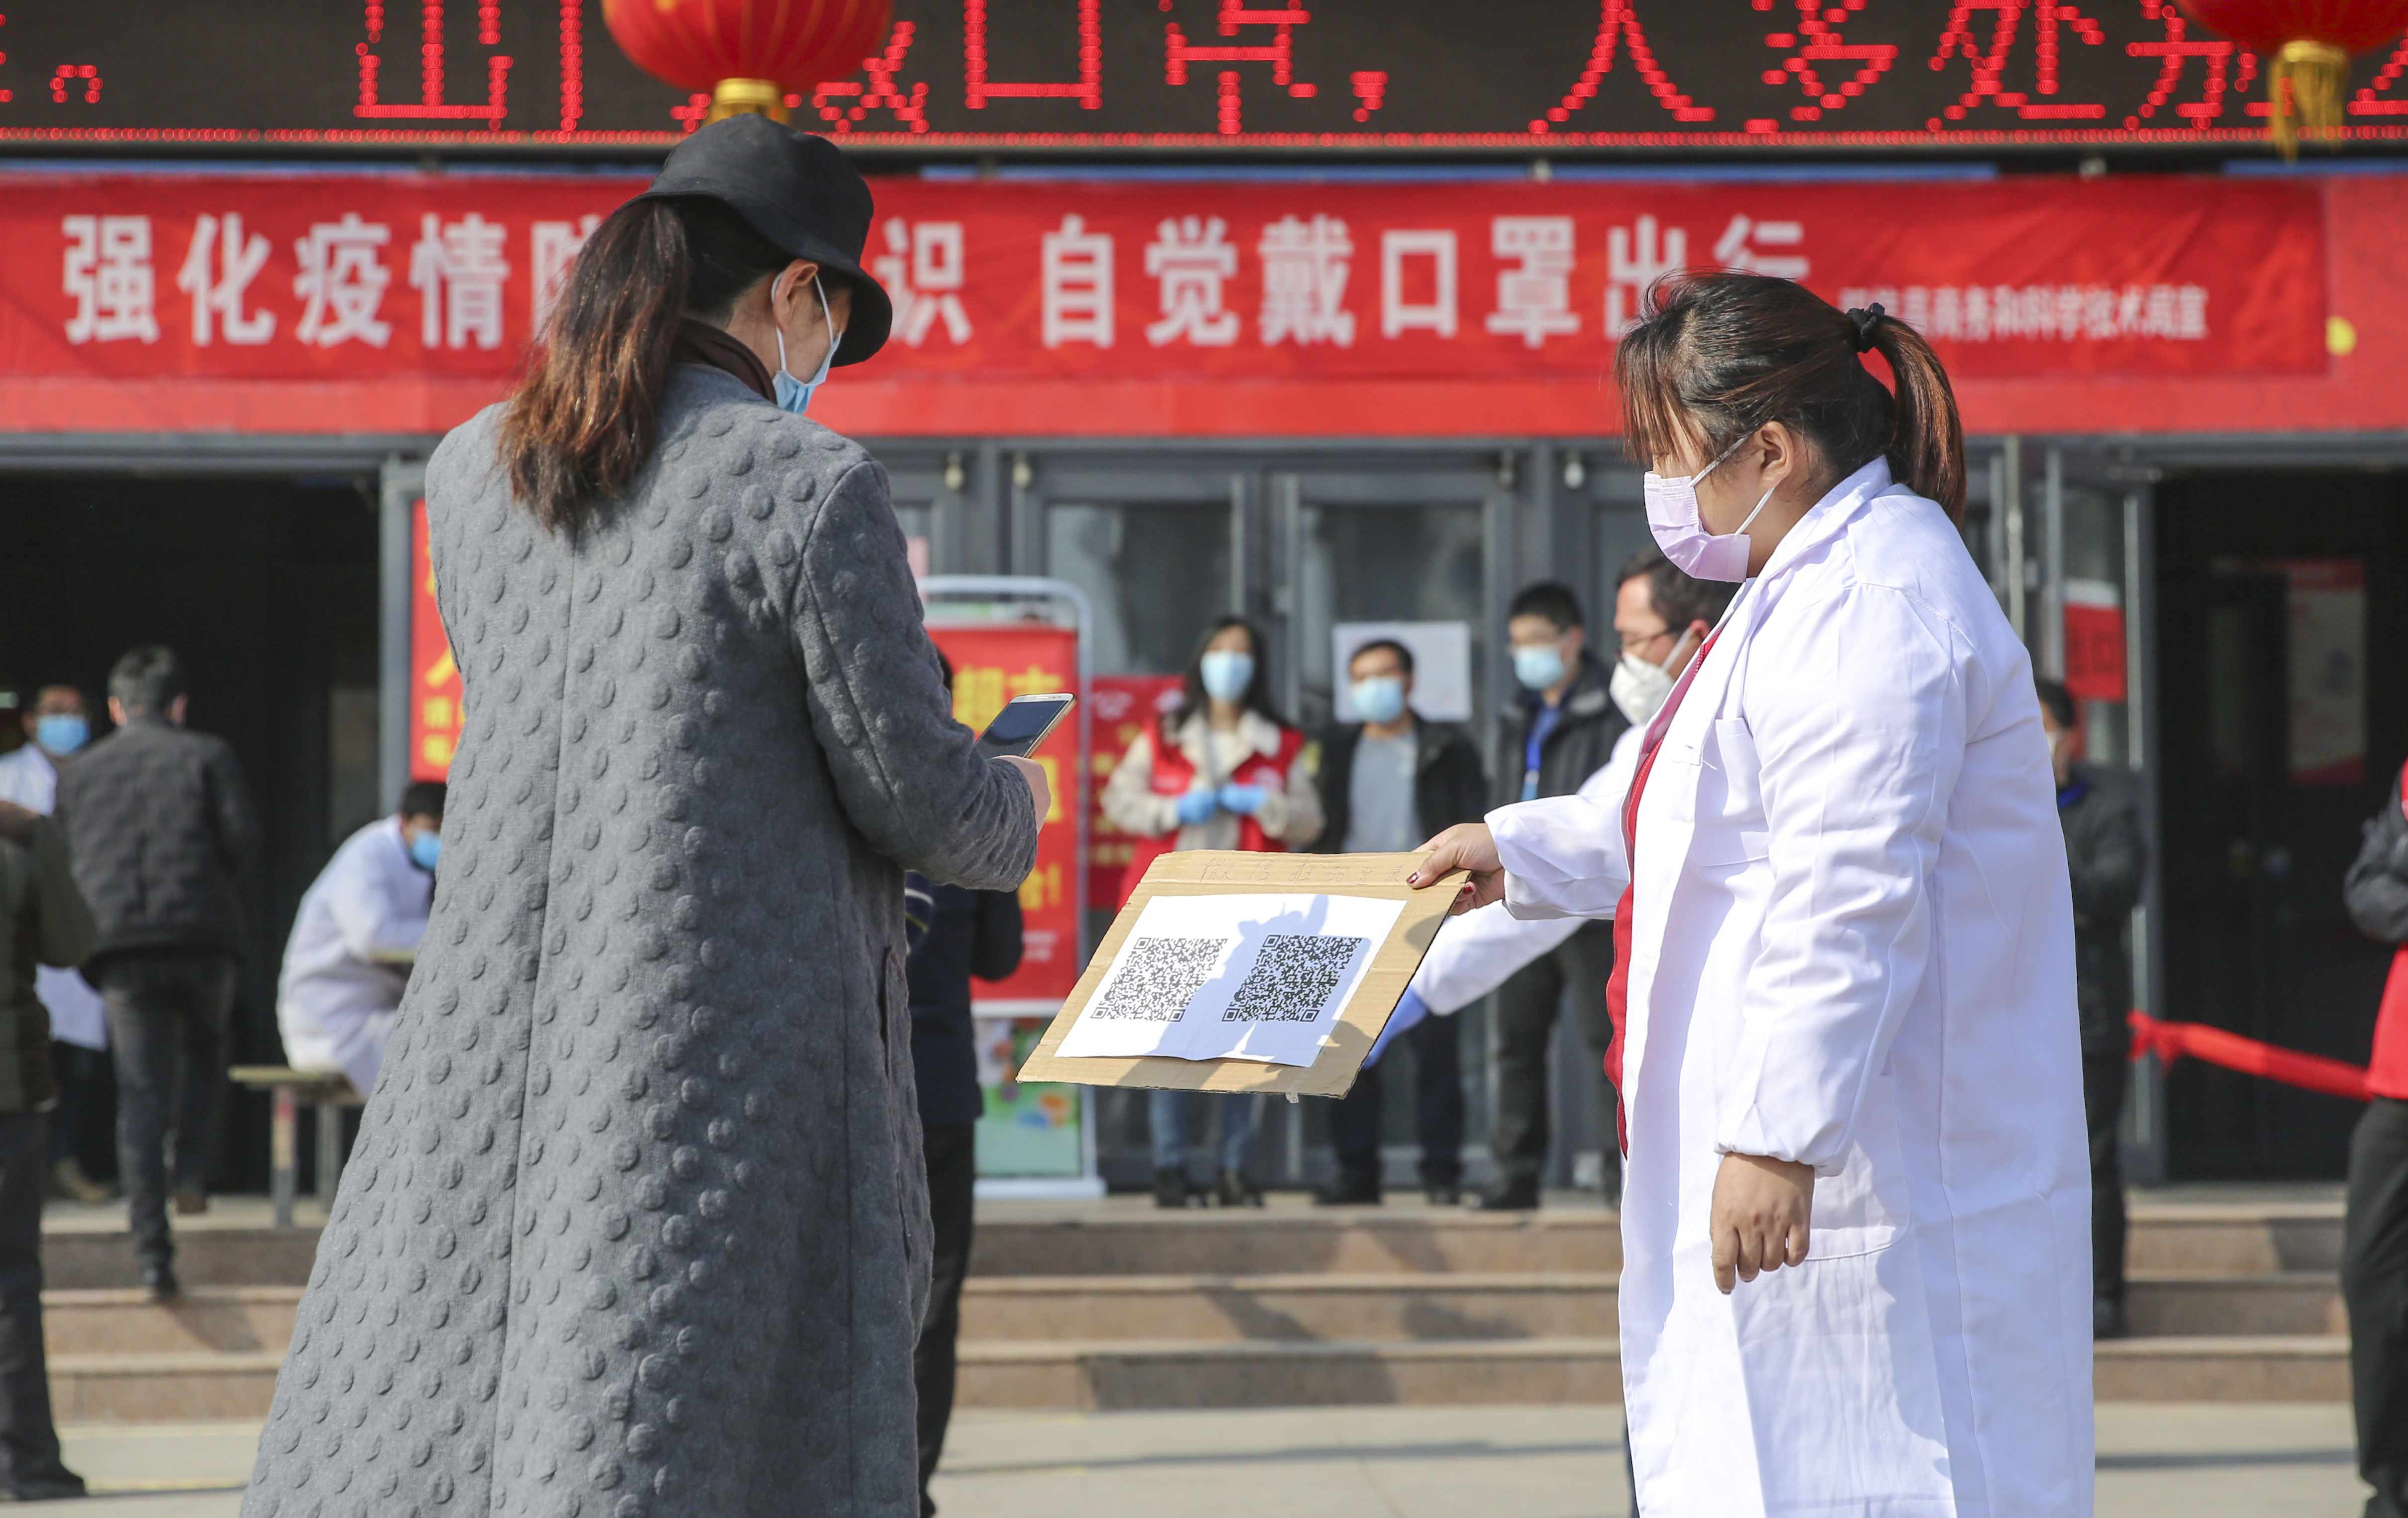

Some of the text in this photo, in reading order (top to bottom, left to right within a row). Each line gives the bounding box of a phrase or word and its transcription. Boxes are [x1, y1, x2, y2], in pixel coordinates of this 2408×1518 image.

[62, 211, 972, 350] 强化疫情防识
